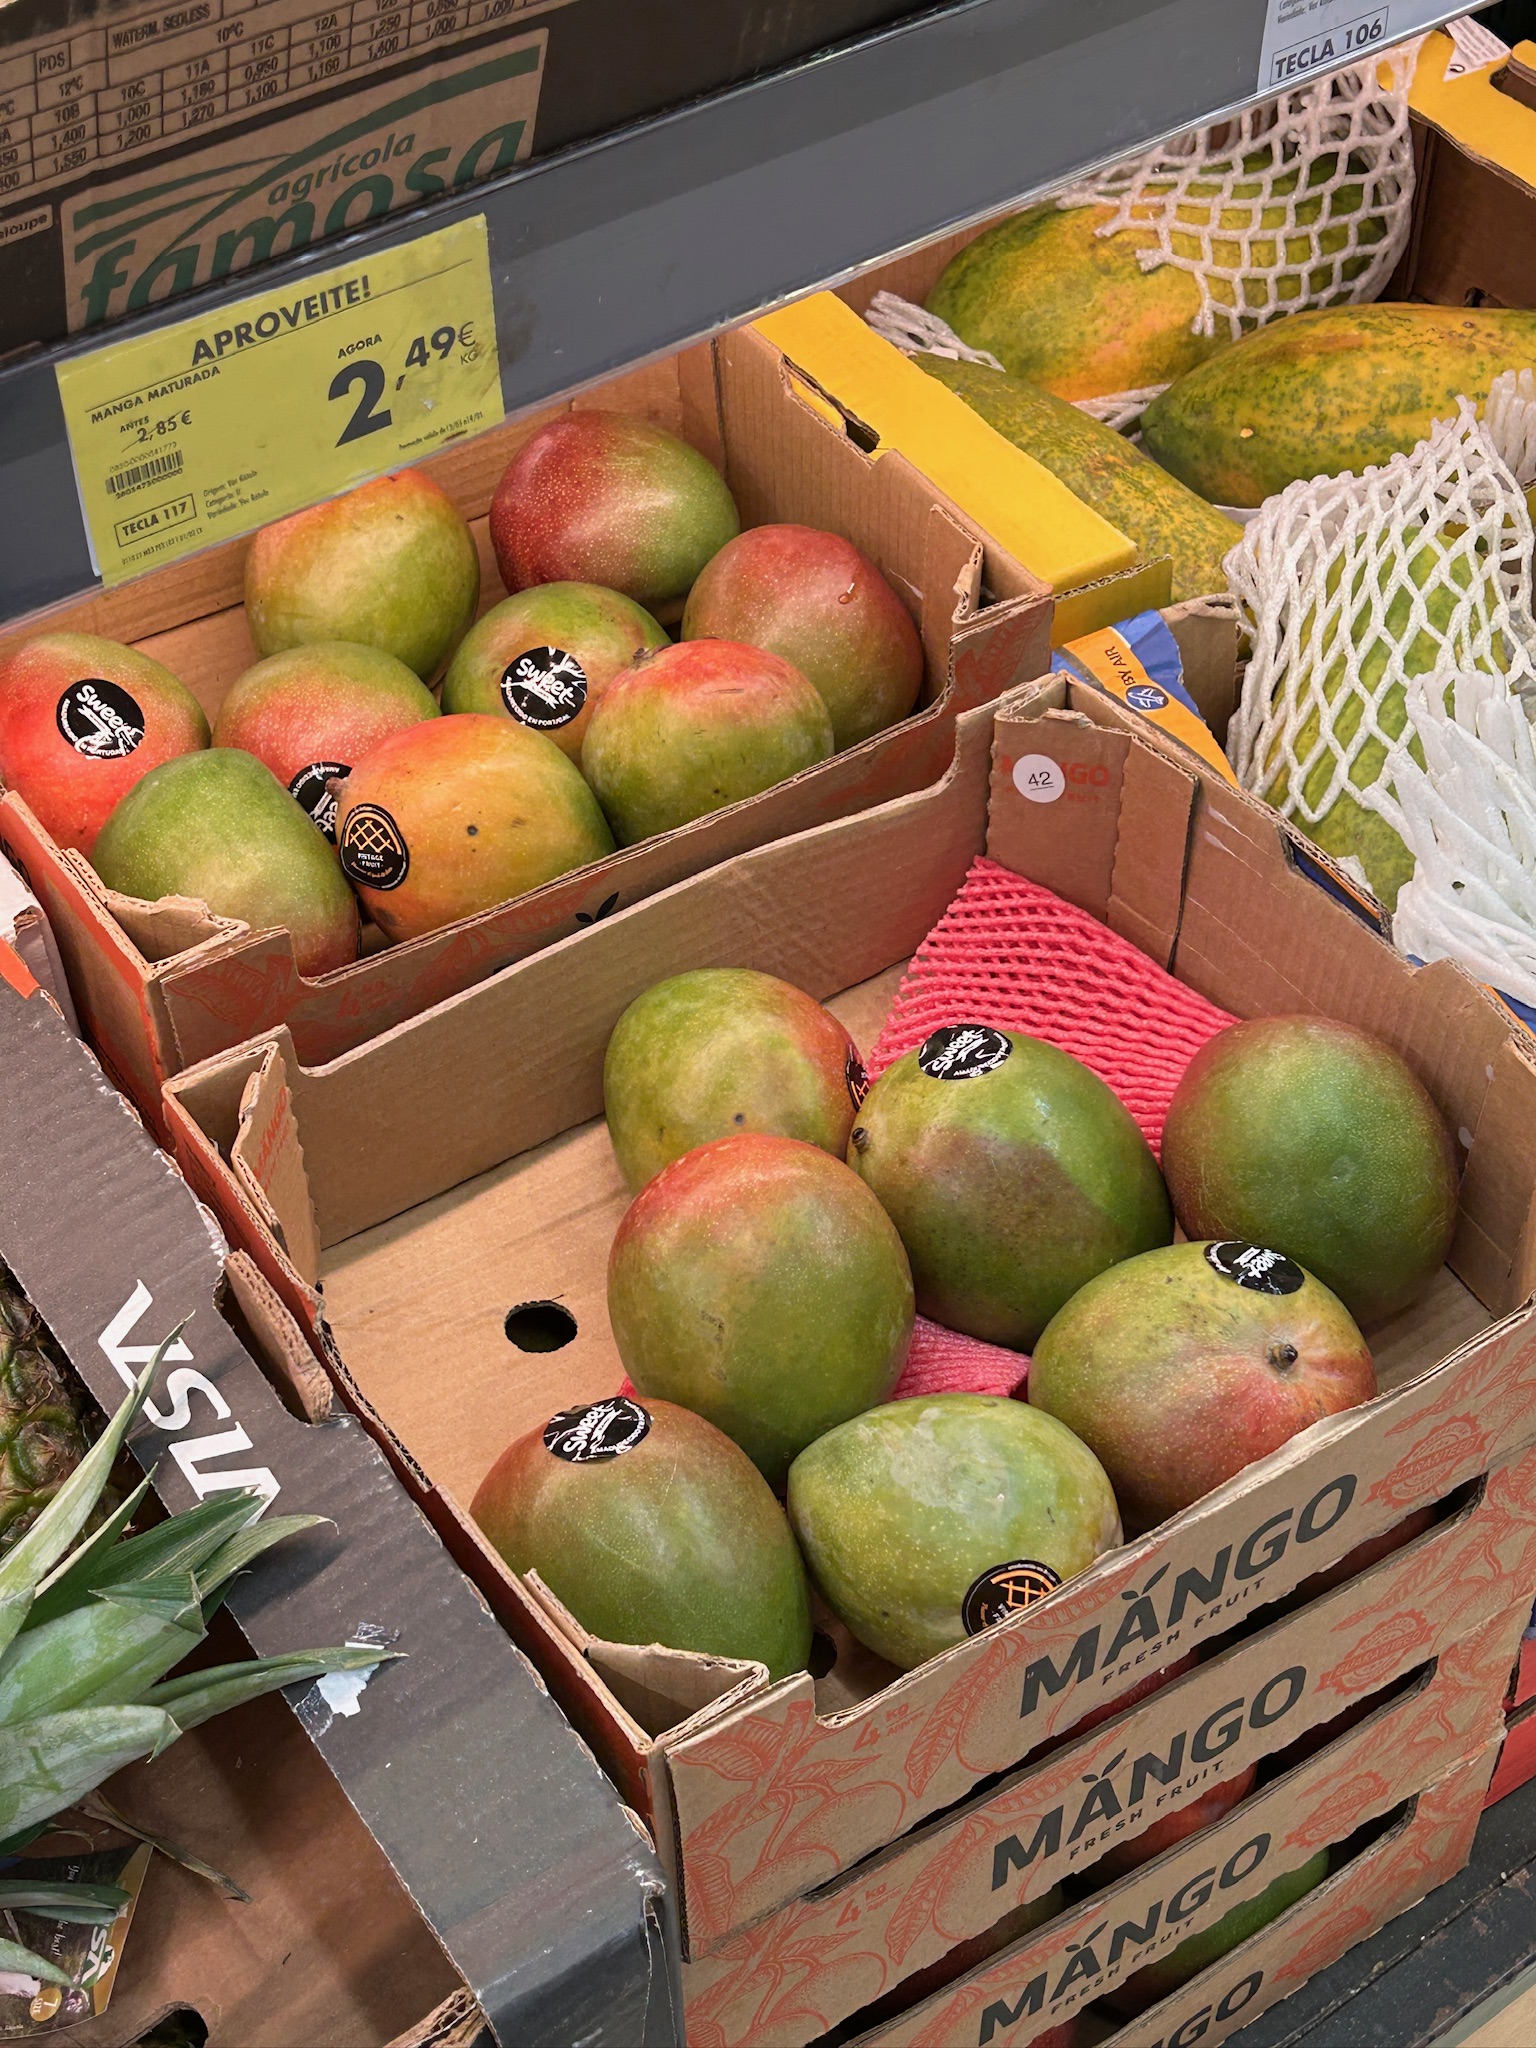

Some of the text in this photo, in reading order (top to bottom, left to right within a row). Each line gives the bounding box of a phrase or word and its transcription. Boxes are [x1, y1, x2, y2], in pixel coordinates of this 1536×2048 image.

[315, 13, 338, 34] 12A
[1275, 17, 1382, 79] TECLA 106
[267, 132, 416, 206] agrícola
[191, 275, 372, 366] APROVEITE!
[337, 333, 383, 360] AGORA
[460, 350, 480, 366] KG
[91, 366, 221, 425] MANGA MATURADA
[119, 415, 150, 434] ANTES
[121, 513, 160, 537] TECLA
[163, 500, 188, 520] 117
[1104, 645, 1137, 687] BY AIR
[1027, 771, 1053, 787] 42
[1101, 1576, 1266, 1687] FRESH FRUIT
[1069, 1760, 1224, 1861] FRESH FRUIT
[1051, 1964, 1121, 2015] FRESH
[1131, 1916, 1195, 1964] FRUIT
